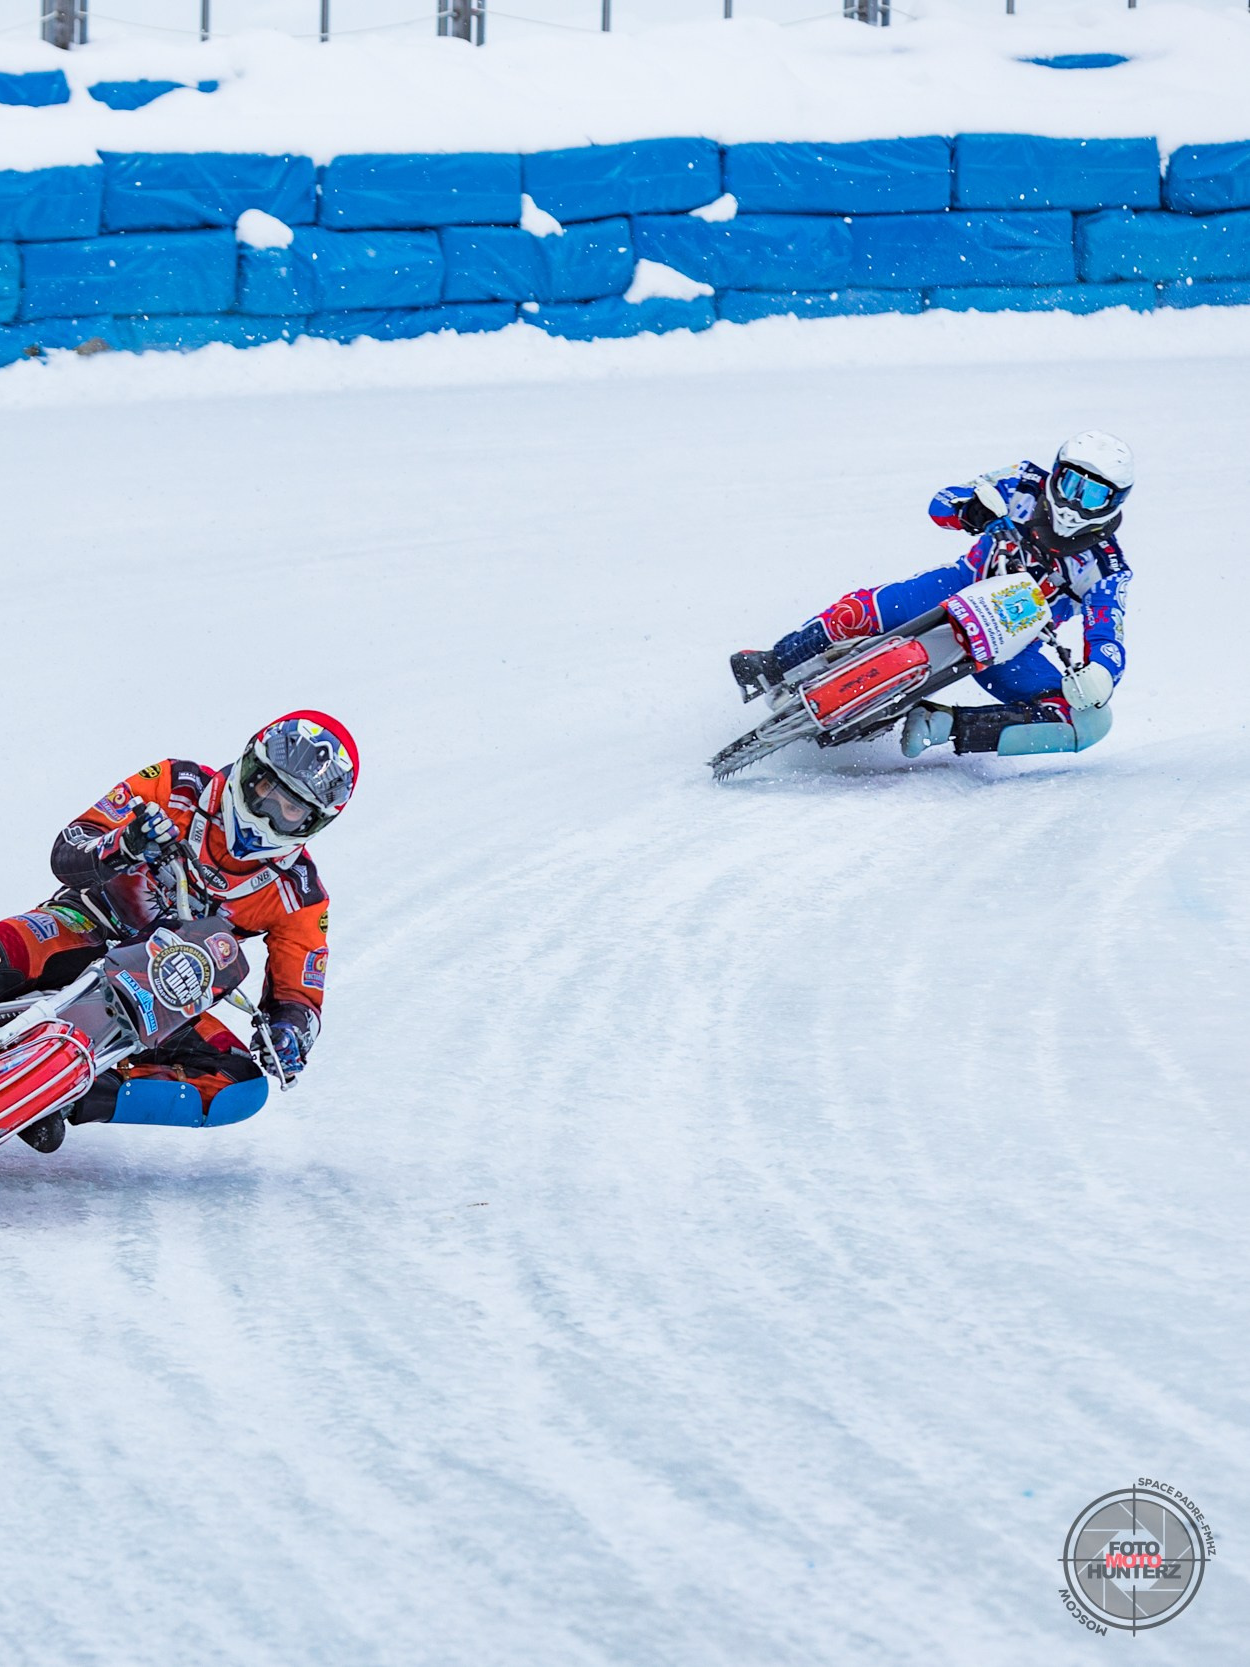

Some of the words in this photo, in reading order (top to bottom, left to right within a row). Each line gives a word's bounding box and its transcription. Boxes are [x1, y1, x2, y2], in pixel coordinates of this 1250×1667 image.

[977, 597, 1005, 645] Правительство
[161, 945, 207, 966] СПОРТИВНЫЙ
[171, 952, 202, 1000] ТОРПЕДО
[165, 971, 192, 1005] ШААЗ
